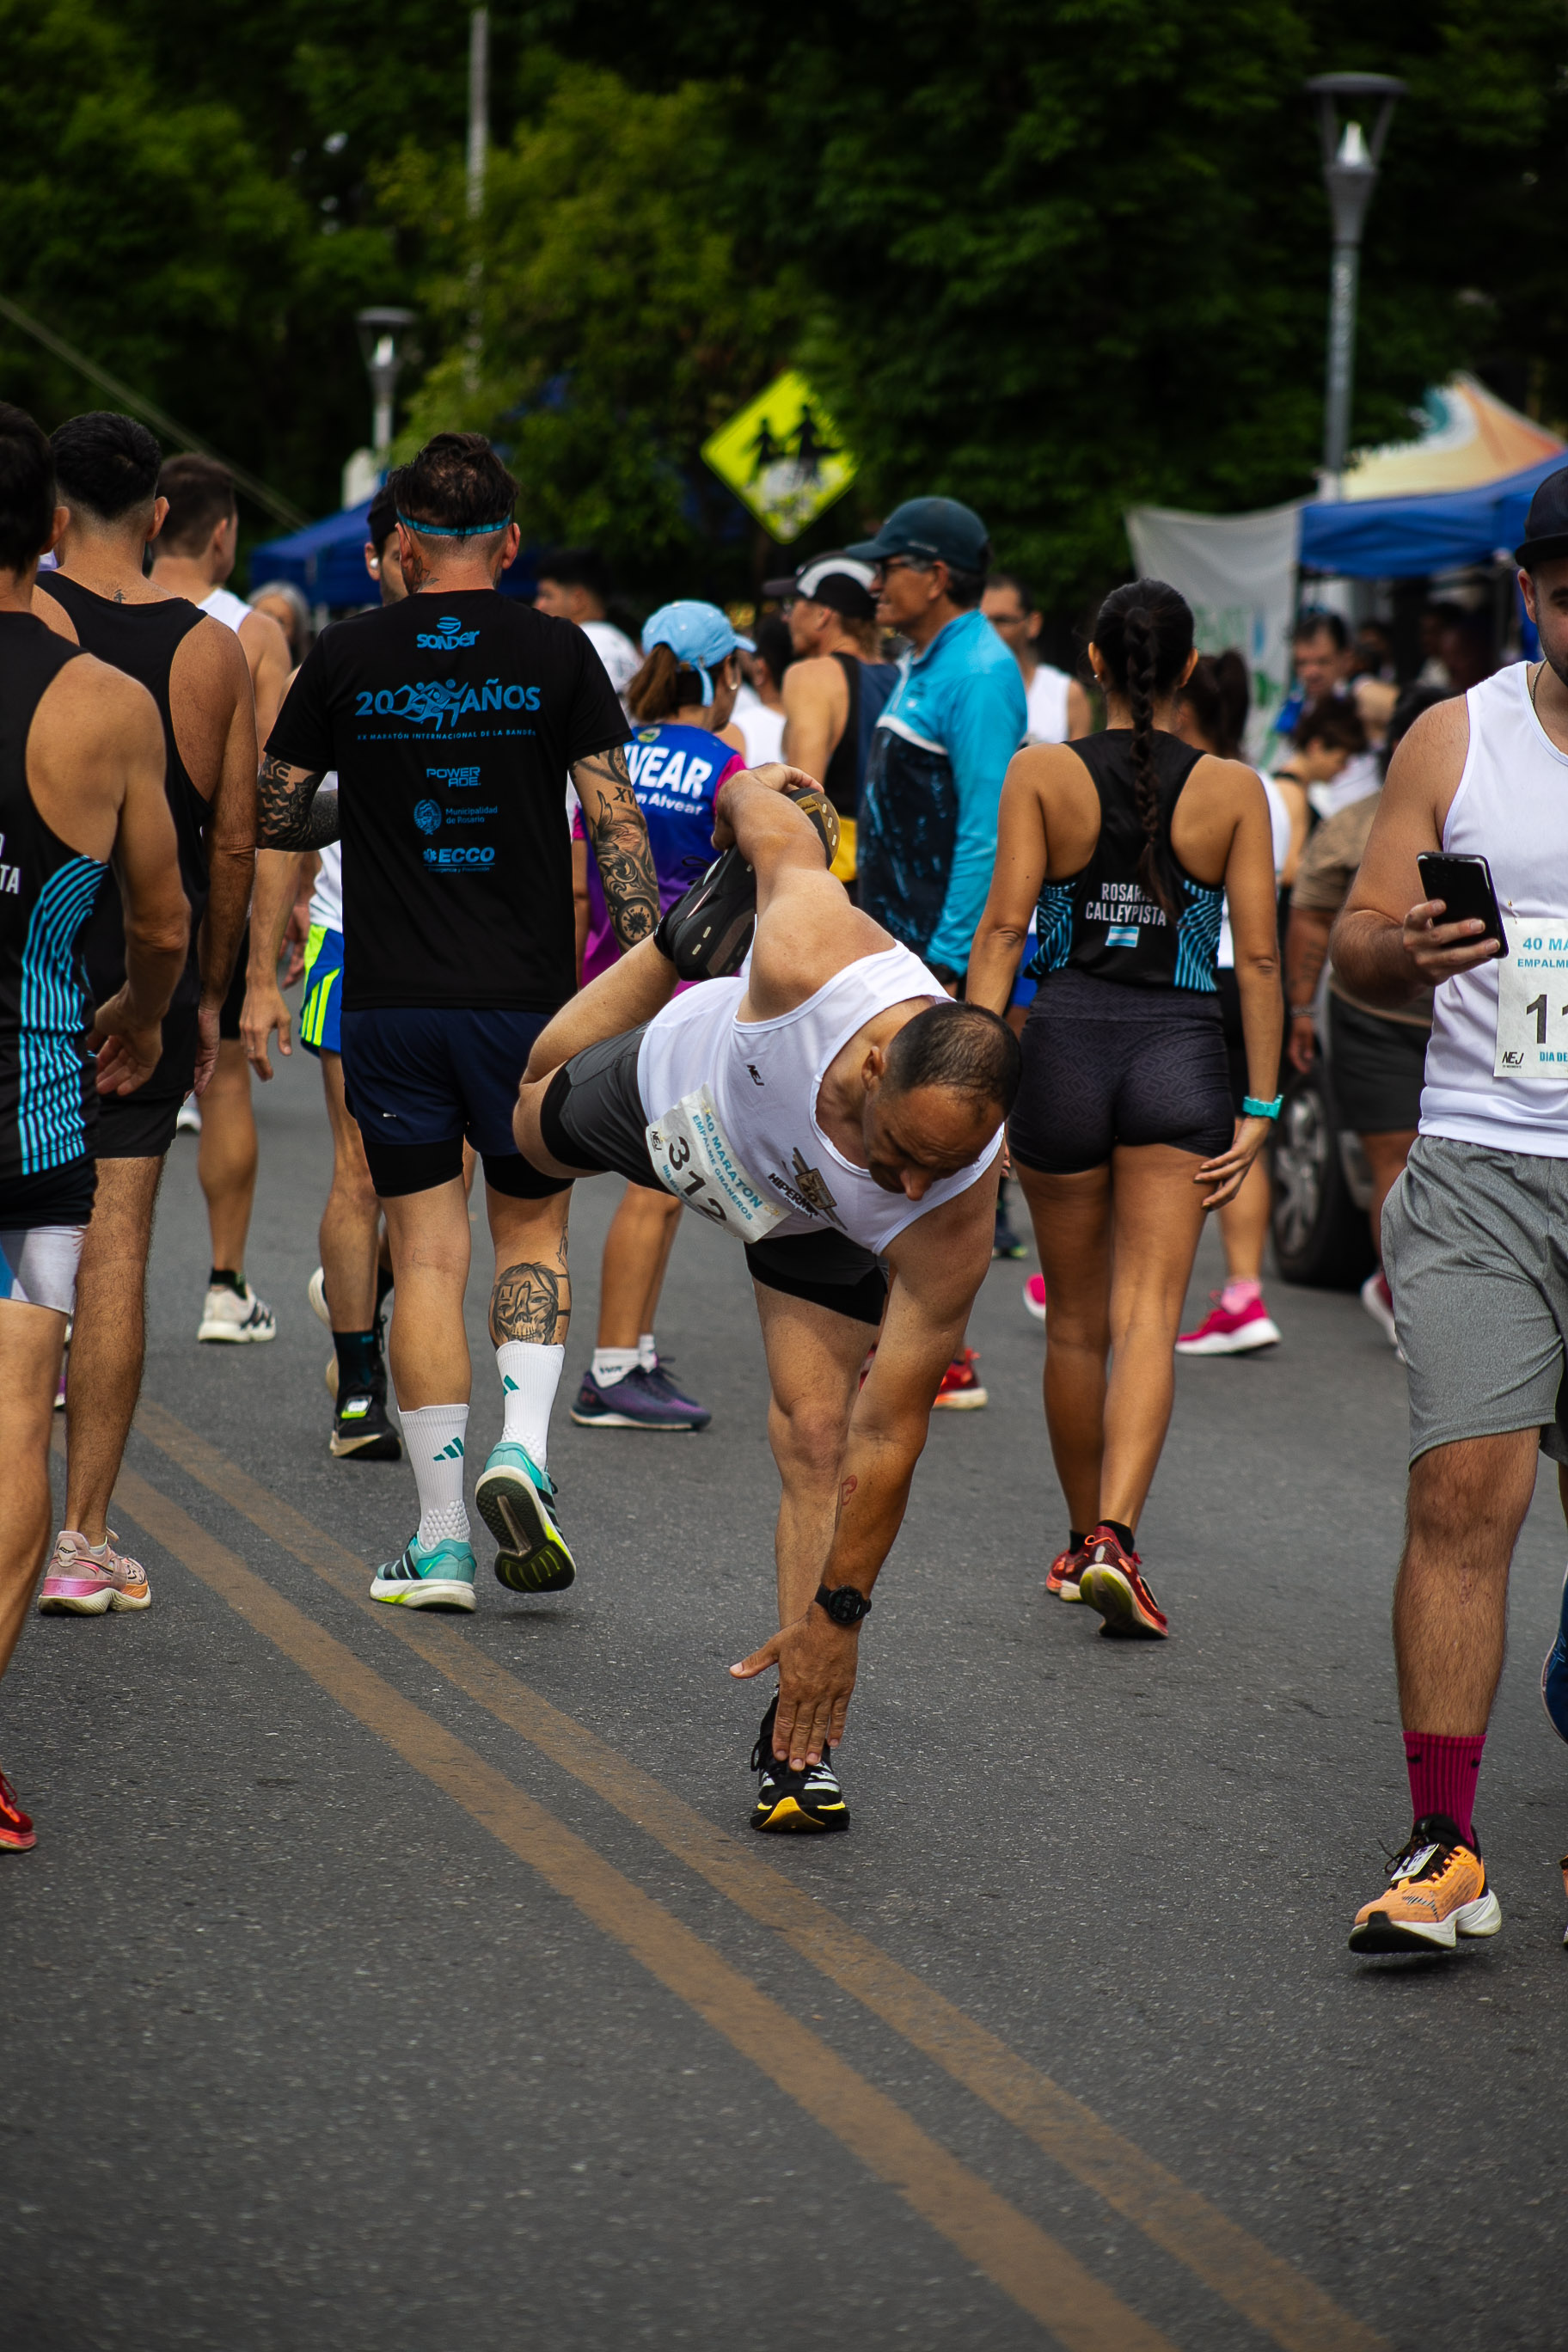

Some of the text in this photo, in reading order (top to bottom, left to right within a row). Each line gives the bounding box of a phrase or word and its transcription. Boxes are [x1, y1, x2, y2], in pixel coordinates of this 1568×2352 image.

[354, 678, 542, 716] 20 AÑOS
[370, 732, 409, 741] MARATÓN
[412, 731, 477, 740] INTERNACIONAL
[426, 767, 481, 779] POWER
[445, 805, 498, 816] Municipalidad
[649, 793, 703, 815] Alvear
[457, 816, 485, 824] Rosario
[438, 847, 495, 863] ECCO
[1522, 937, 1543, 951] 40
[1526, 994, 1568, 1044] 1
[1502, 1051, 1524, 1065] NEJ
[1540, 1051, 1555, 1062] DIA
[746, 1064, 765, 1087] NEJ
[691, 1114, 717, 1166] EMPALME
[714, 1167, 754, 1221] GRANEROS
[712, 1135, 763, 1209] MARATON
[668, 1136, 728, 1225] 312
